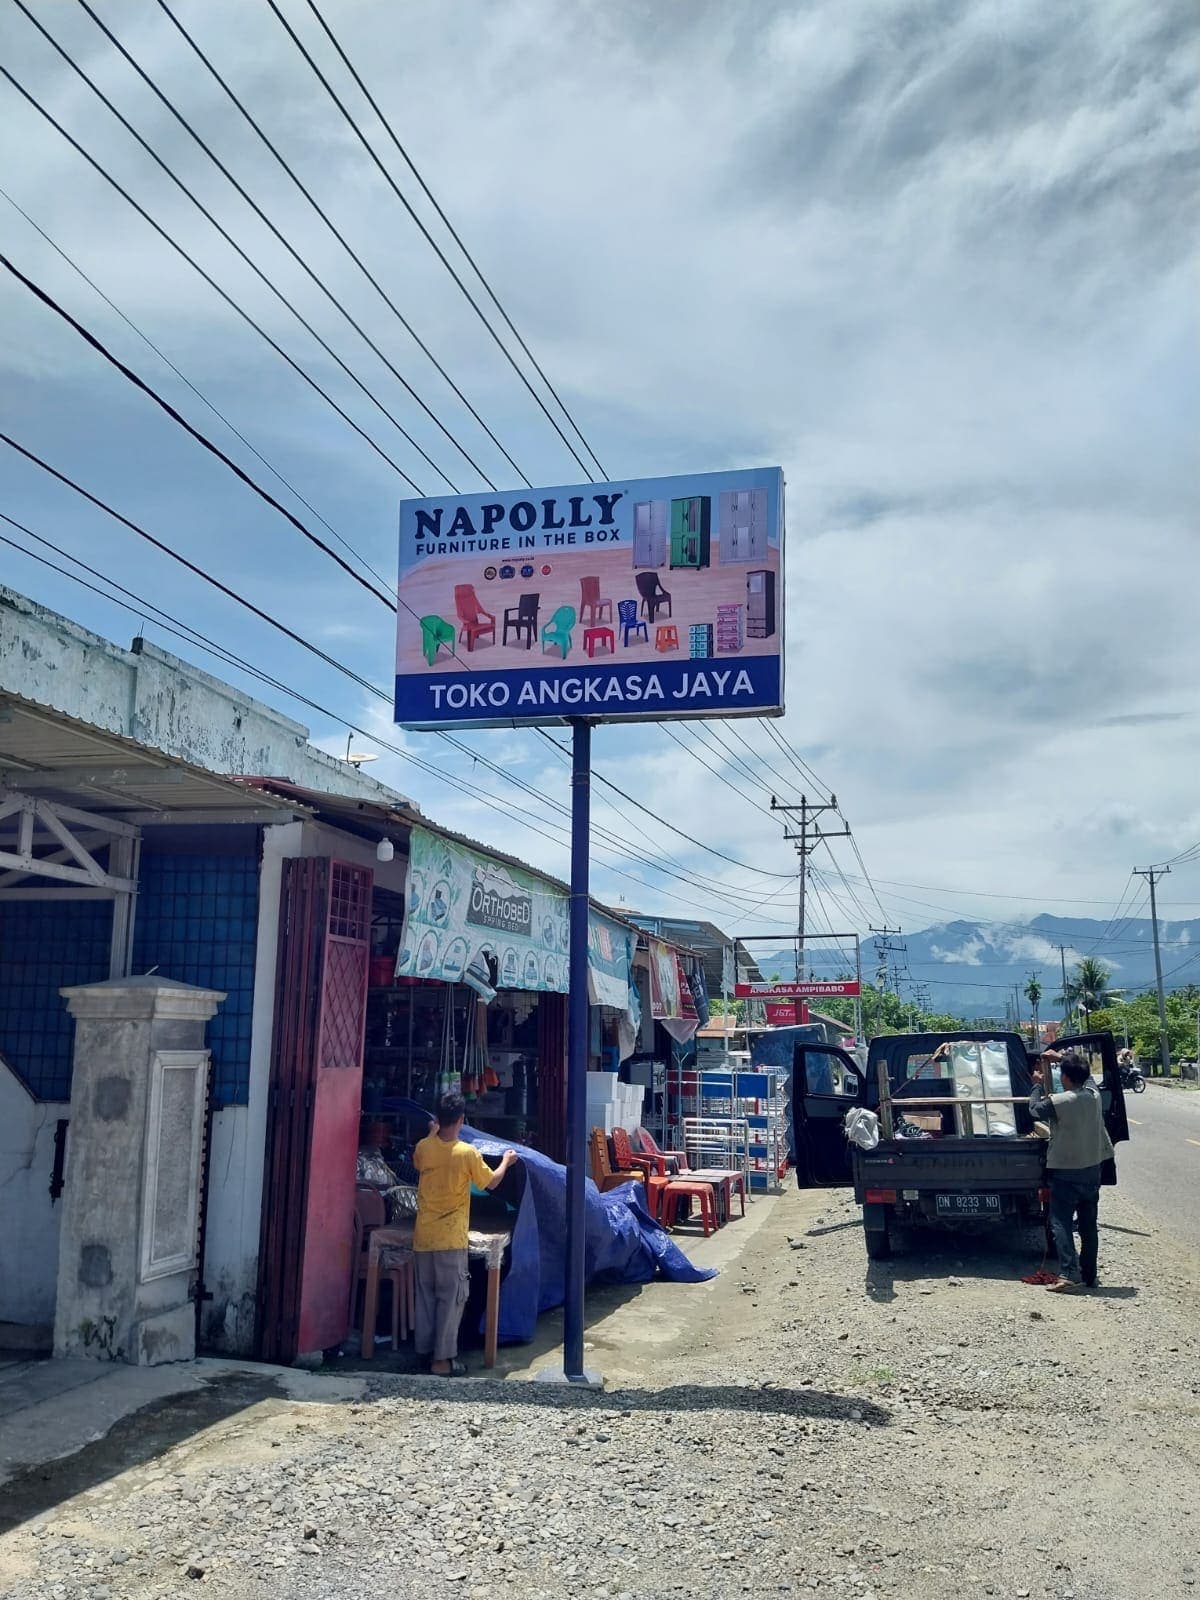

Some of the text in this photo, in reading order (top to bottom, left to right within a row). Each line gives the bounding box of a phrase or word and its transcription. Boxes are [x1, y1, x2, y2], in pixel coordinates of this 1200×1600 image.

[414, 493, 623, 540] NAPOLLY
[416, 529, 620, 556] FURNITURE IN THE BOX
[429, 670, 754, 709] TOKO ANGKASA JAYA
[938, 1196, 998, 1208] DN 8233 ND
